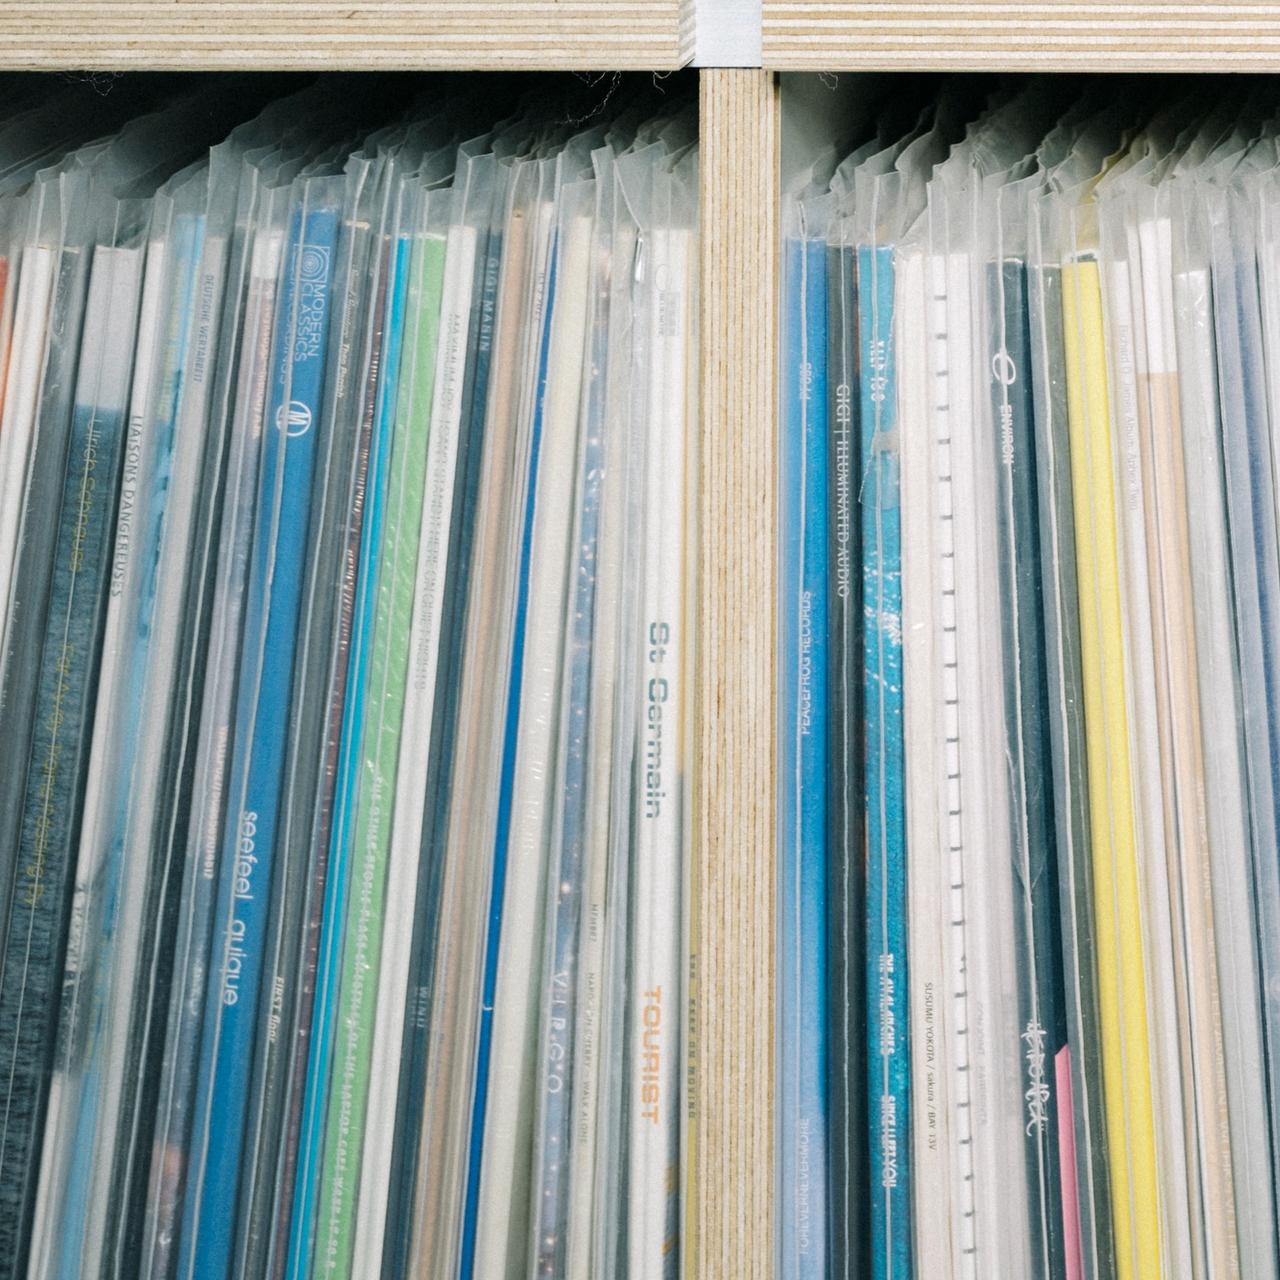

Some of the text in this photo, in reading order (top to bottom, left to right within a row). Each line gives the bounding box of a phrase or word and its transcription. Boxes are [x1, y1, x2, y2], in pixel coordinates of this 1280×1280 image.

[292, 282, 315, 362] CLASSICS
[304, 283, 327, 358] MODERN
[122, 414, 144, 485] LIAISONS
[835, 384, 850, 599] GIGI ILLUMINATED AUDIO
[648, 621, 670, 664] St
[220, 810, 260, 1006] seefeel quique
[922, 982, 935, 1023] SUSUMU
[639, 983, 663, 1127] TOURIST
[924, 1025, 936, 1062] YOKOTA
[924, 1071, 937, 1102] sakura
[925, 1111, 938, 1131] BAY
